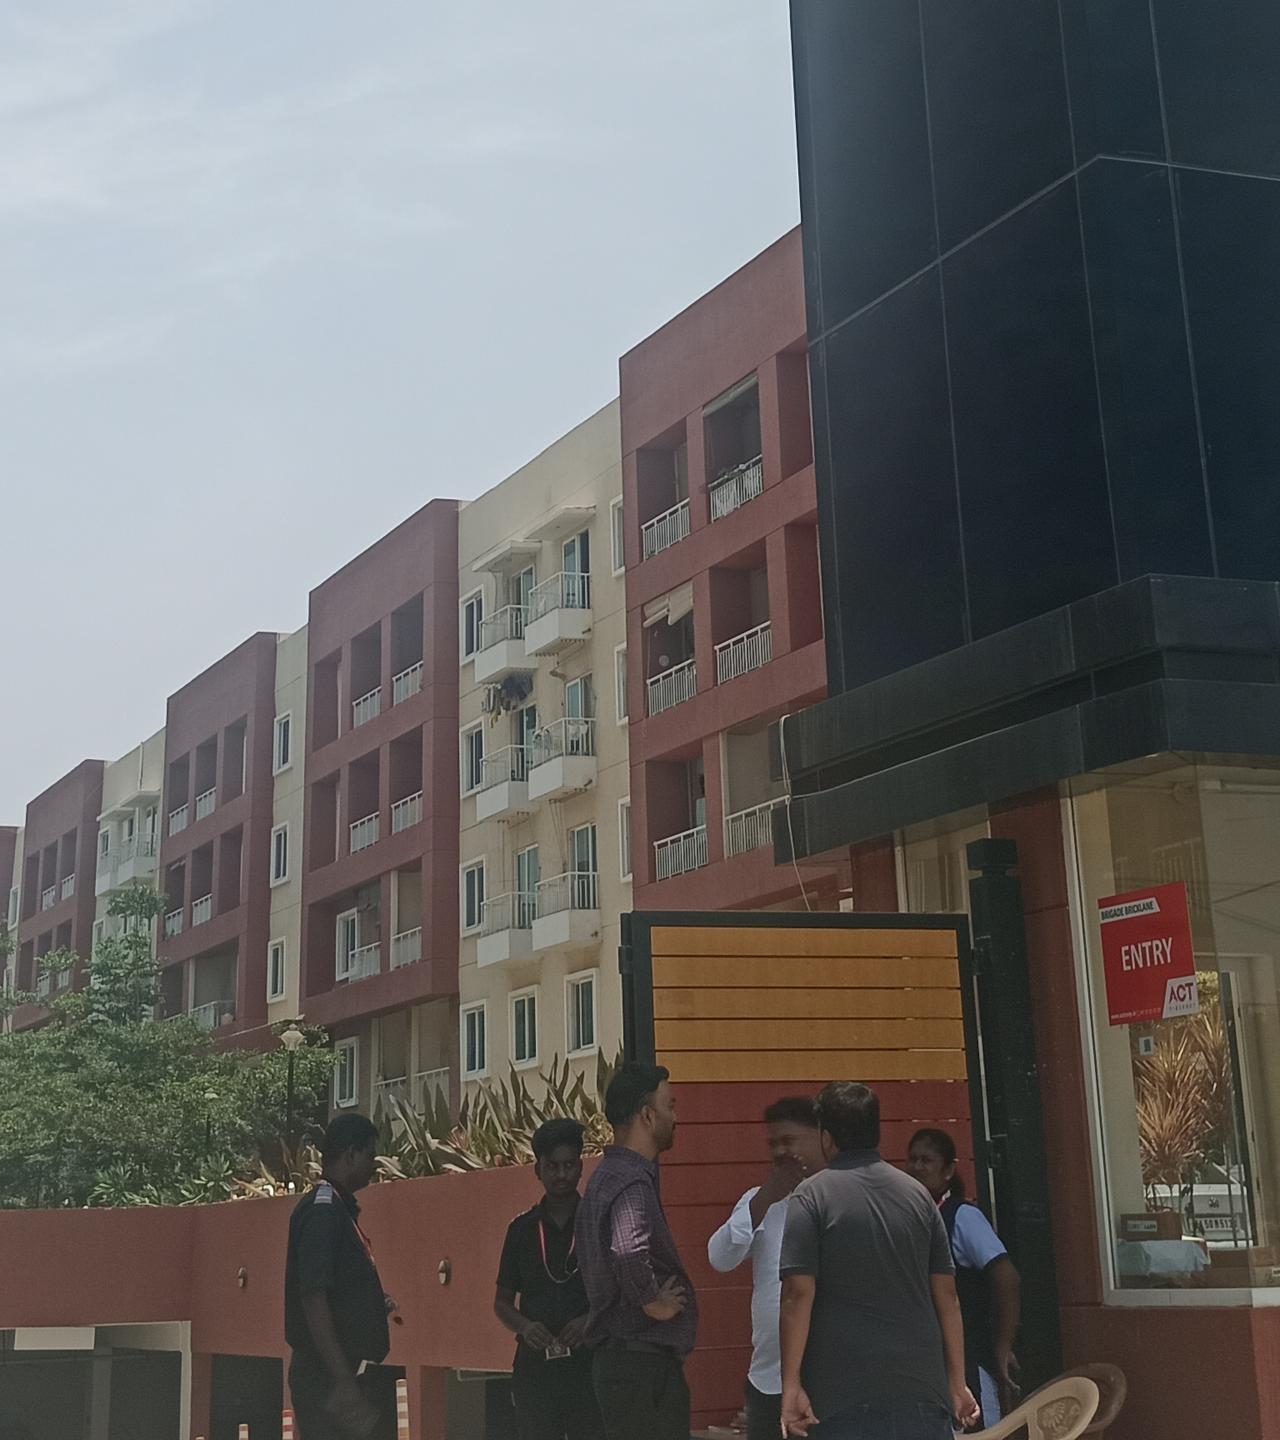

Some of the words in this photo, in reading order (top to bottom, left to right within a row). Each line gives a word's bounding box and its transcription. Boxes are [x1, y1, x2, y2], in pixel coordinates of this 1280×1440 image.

[1101, 906, 1124, 920] BRIGADE
[1124, 900, 1154, 915] BRICKLANE
[1121, 937, 1173, 971] ENTRY
[1169, 982, 1194, 1004] ACT
